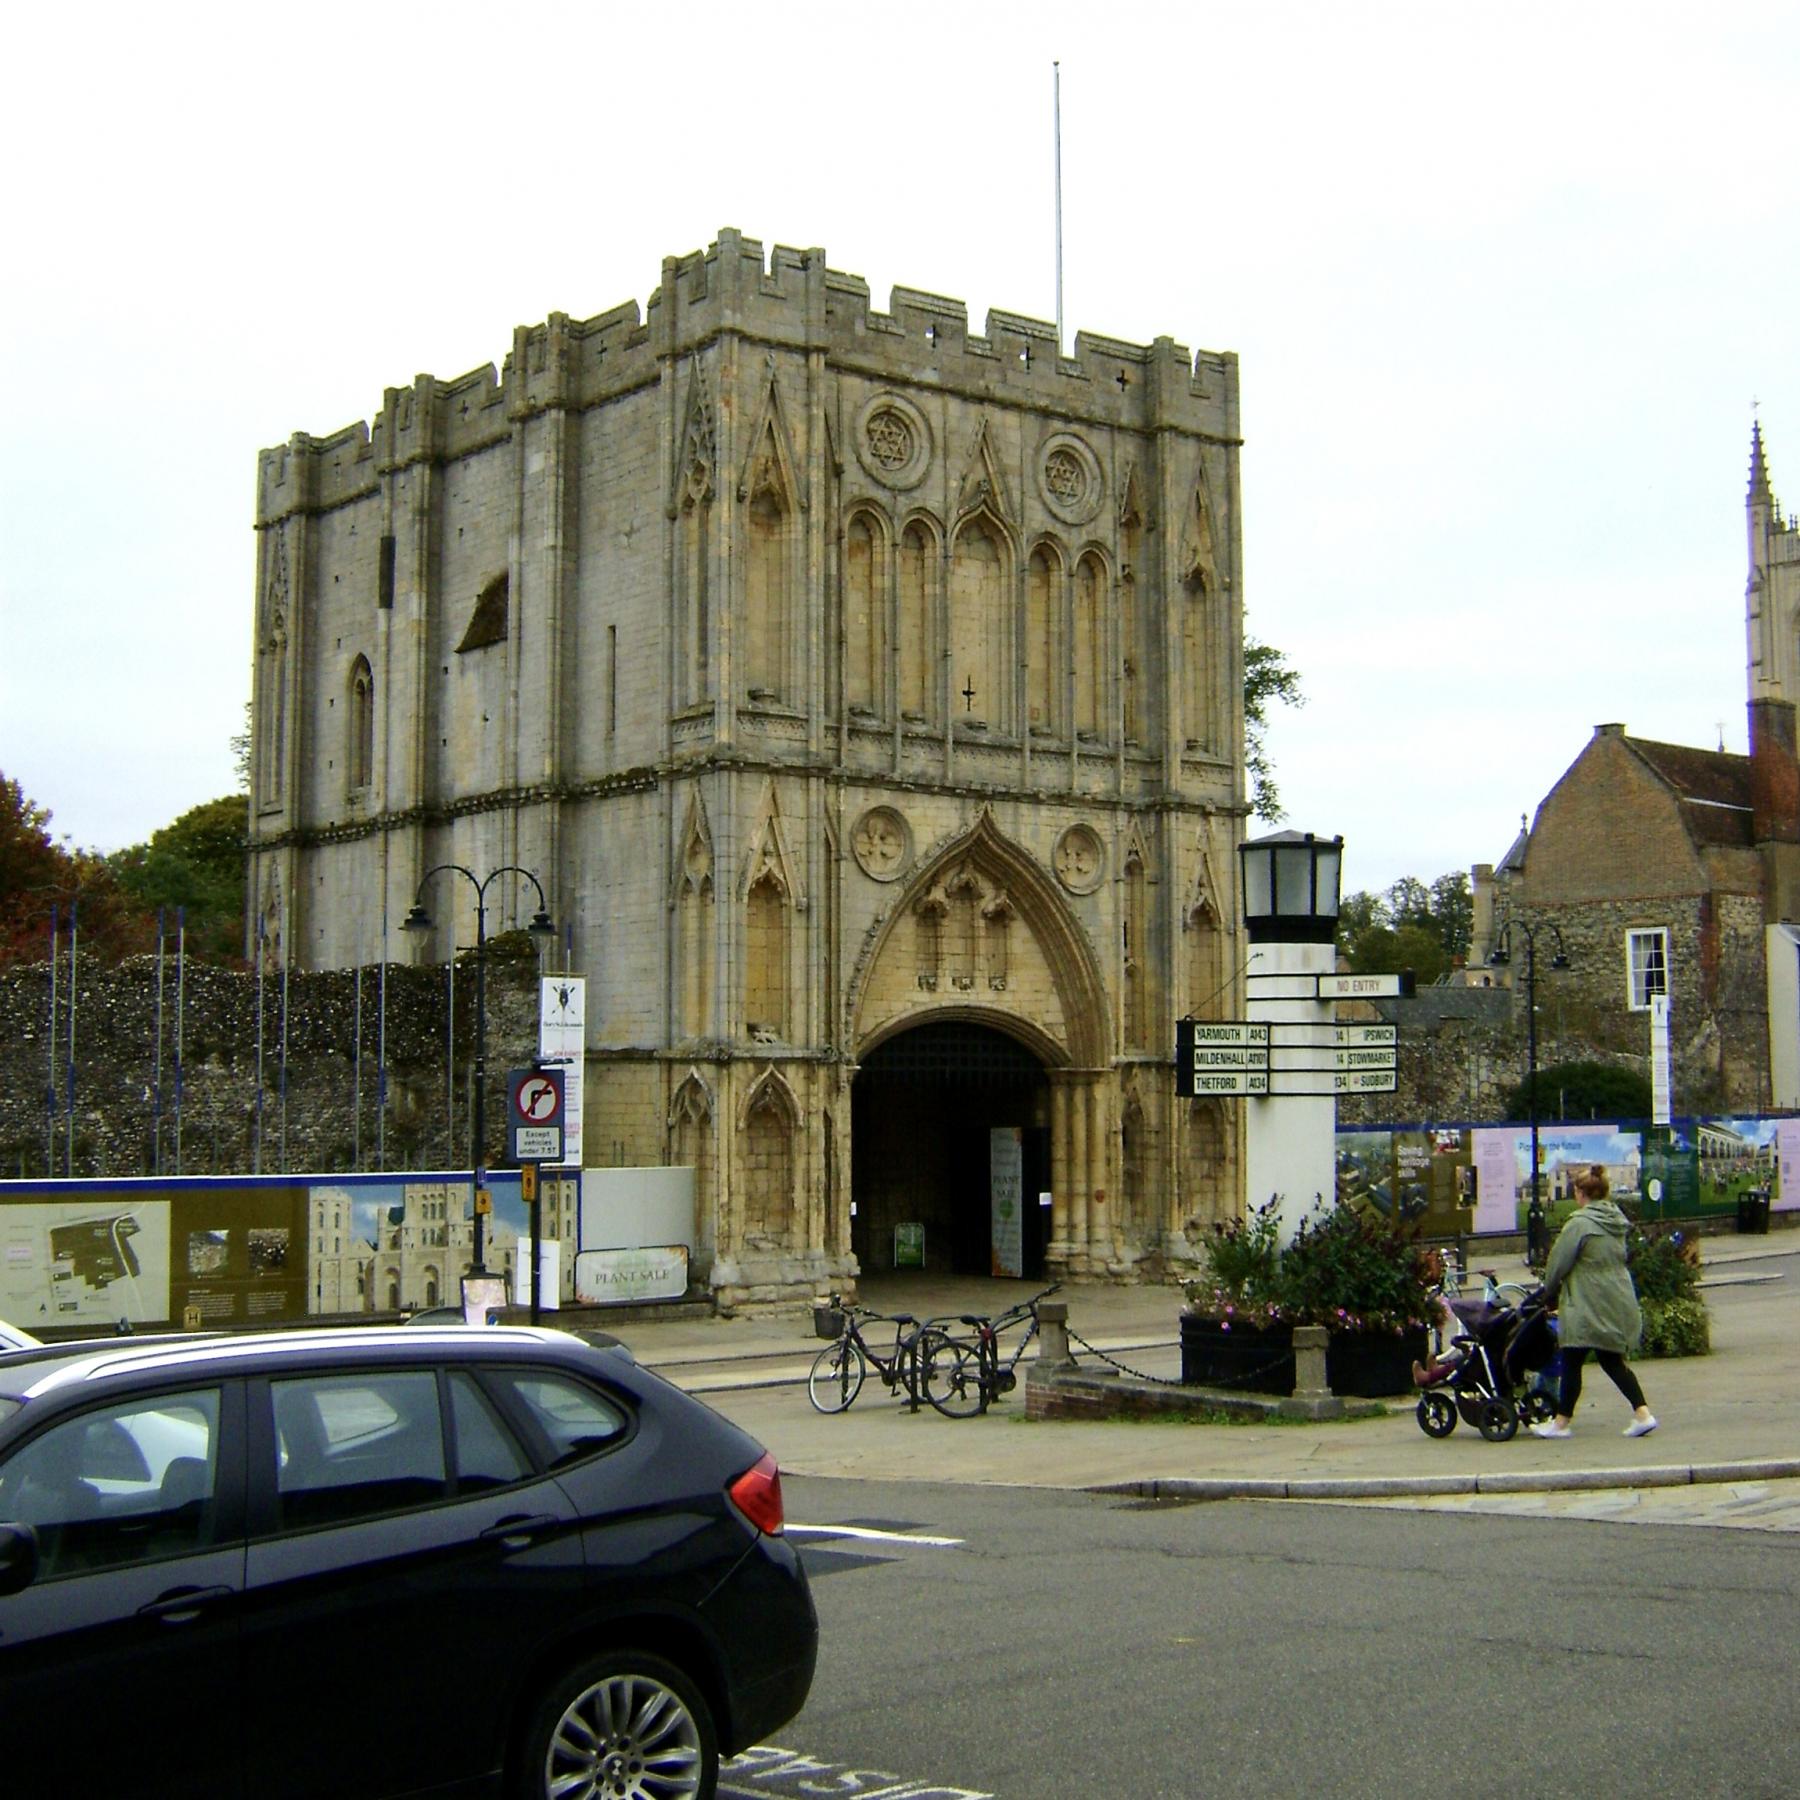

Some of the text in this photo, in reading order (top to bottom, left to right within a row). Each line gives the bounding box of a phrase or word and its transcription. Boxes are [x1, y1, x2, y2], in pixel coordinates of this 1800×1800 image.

[1337, 980, 1381, 992] NO ENTRY
[1196, 1028, 1267, 1041] YARMOUTH A143
[1363, 1029, 1394, 1041] IPSWICH
[1195, 1052, 1246, 1065] MILDENHALL
[1348, 1052, 1396, 1065] STOWMARKET
[1196, 1077, 1266, 1089] THETFORD A134
[1360, 1075, 1393, 1087] SUDBURY
[525, 1130, 551, 1138] Except
[519, 1147, 539, 1155] under
[595, 1268, 670, 1285] PLANT SALE
